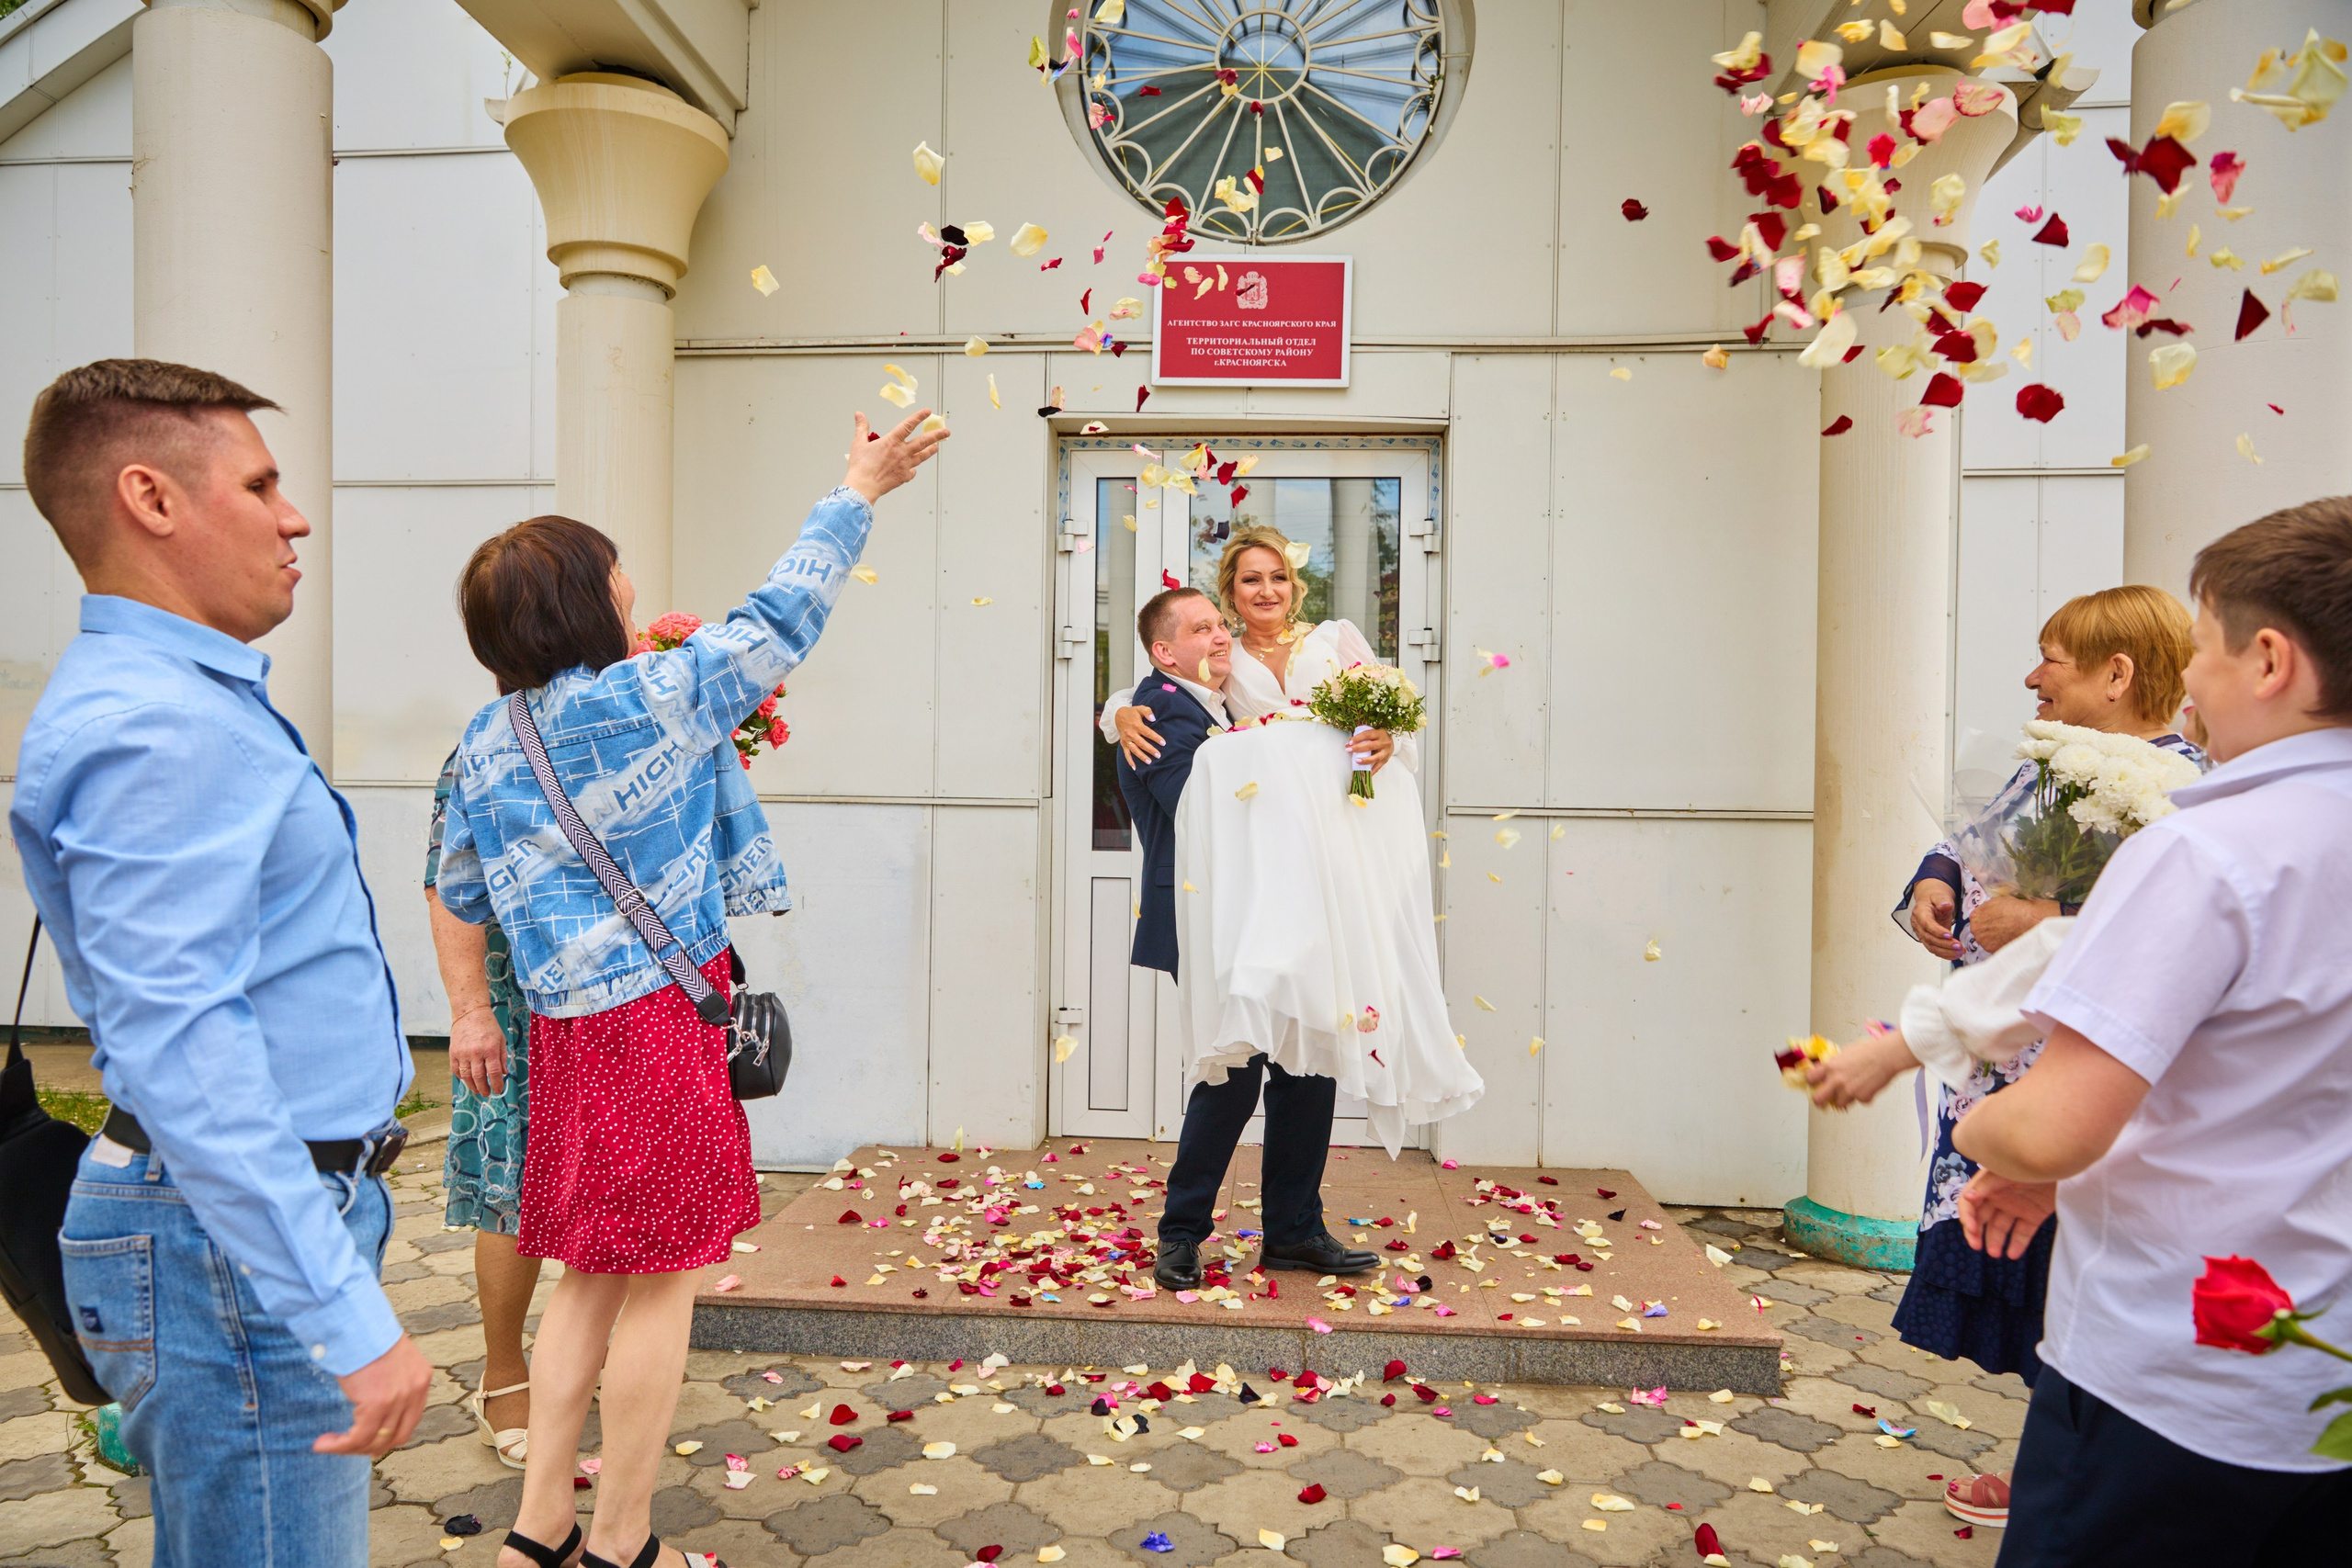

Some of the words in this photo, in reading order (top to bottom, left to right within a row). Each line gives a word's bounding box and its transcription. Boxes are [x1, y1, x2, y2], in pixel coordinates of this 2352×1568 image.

[1241, 320, 1314, 328] КРАСНОЯРСКОГО
[1186, 336, 1283, 345] ТЕРРИТОРИАЛЬНЫЙ
[1284, 338, 1317, 346] ОТДЕЛ
[1206, 348, 1273, 356] СОВЕТСКОМУ
[1274, 347, 1314, 356] РАЙОНУ
[1214, 358, 1287, 367] г.КРАСНОЯРСКА
